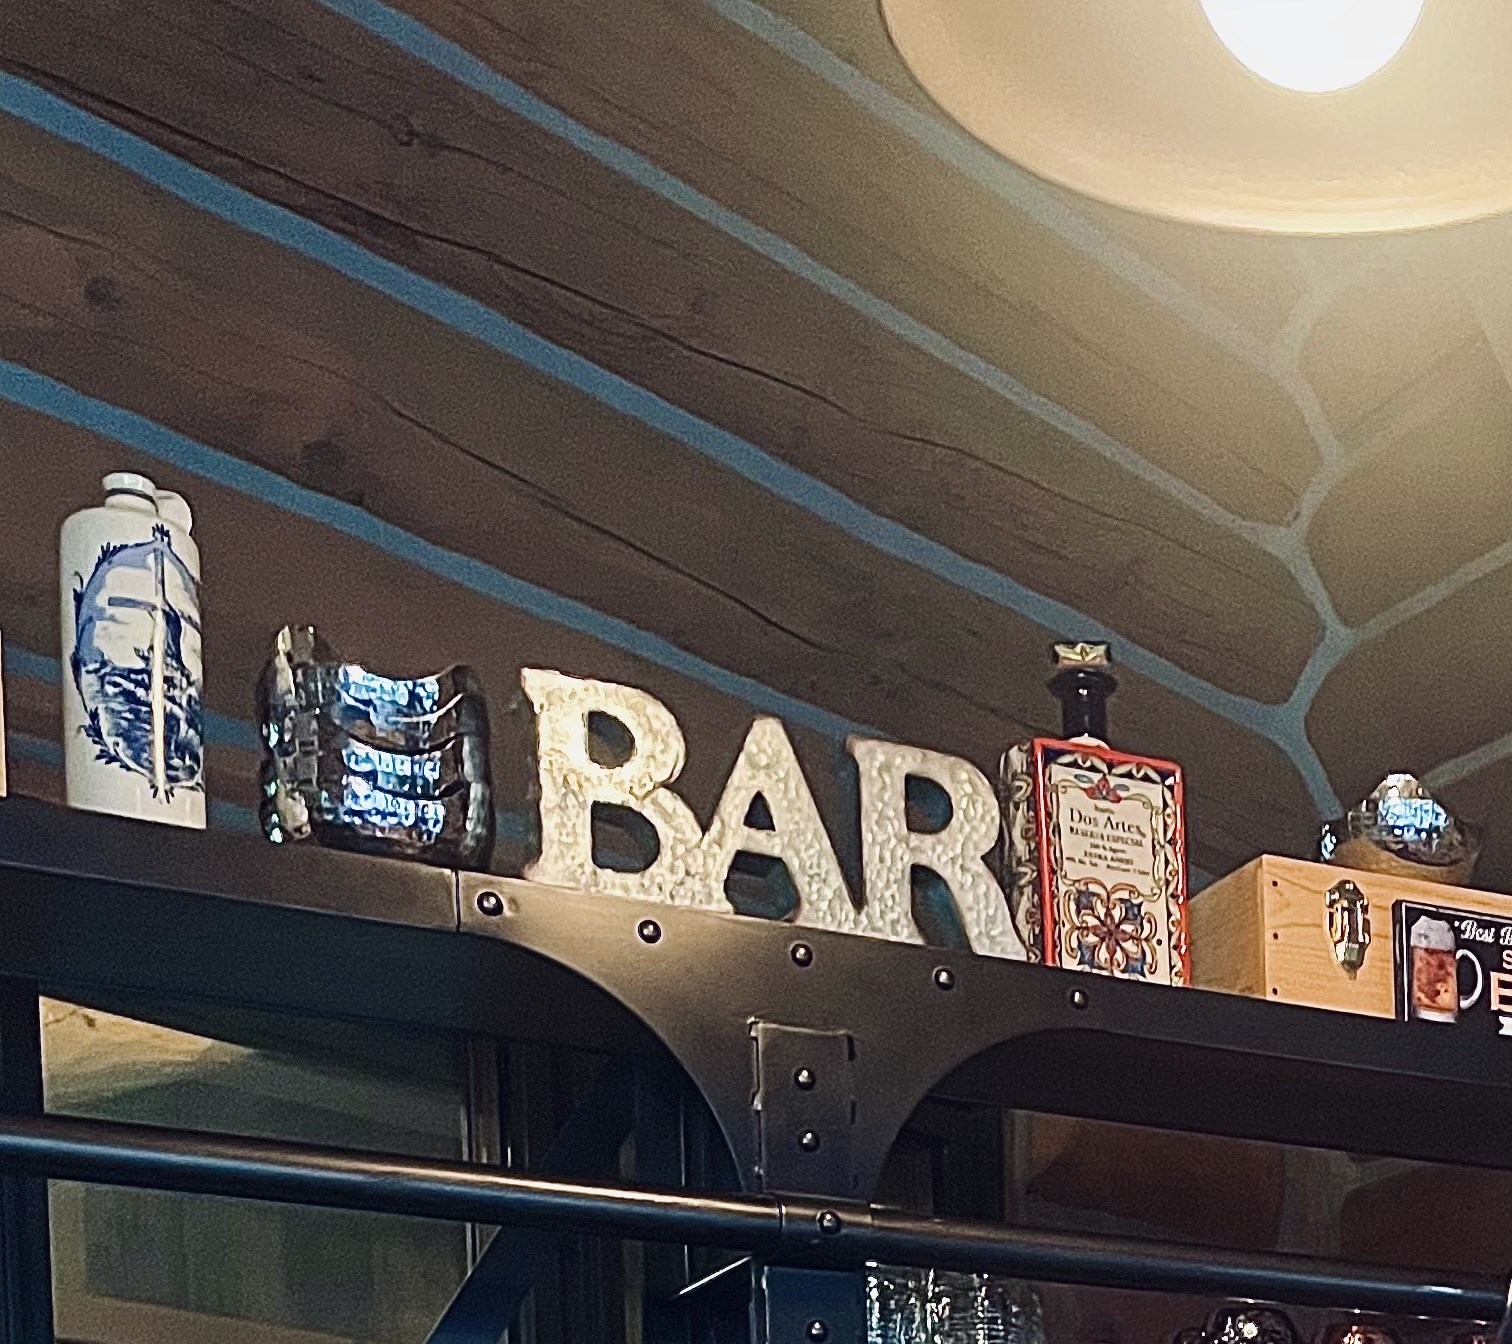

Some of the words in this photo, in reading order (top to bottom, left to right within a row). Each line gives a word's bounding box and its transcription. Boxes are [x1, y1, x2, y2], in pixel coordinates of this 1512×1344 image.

[521, 666, 1030, 964] BAR
[1069, 807, 1099, 829] Dos
[1103, 815, 1147, 839] Artes
